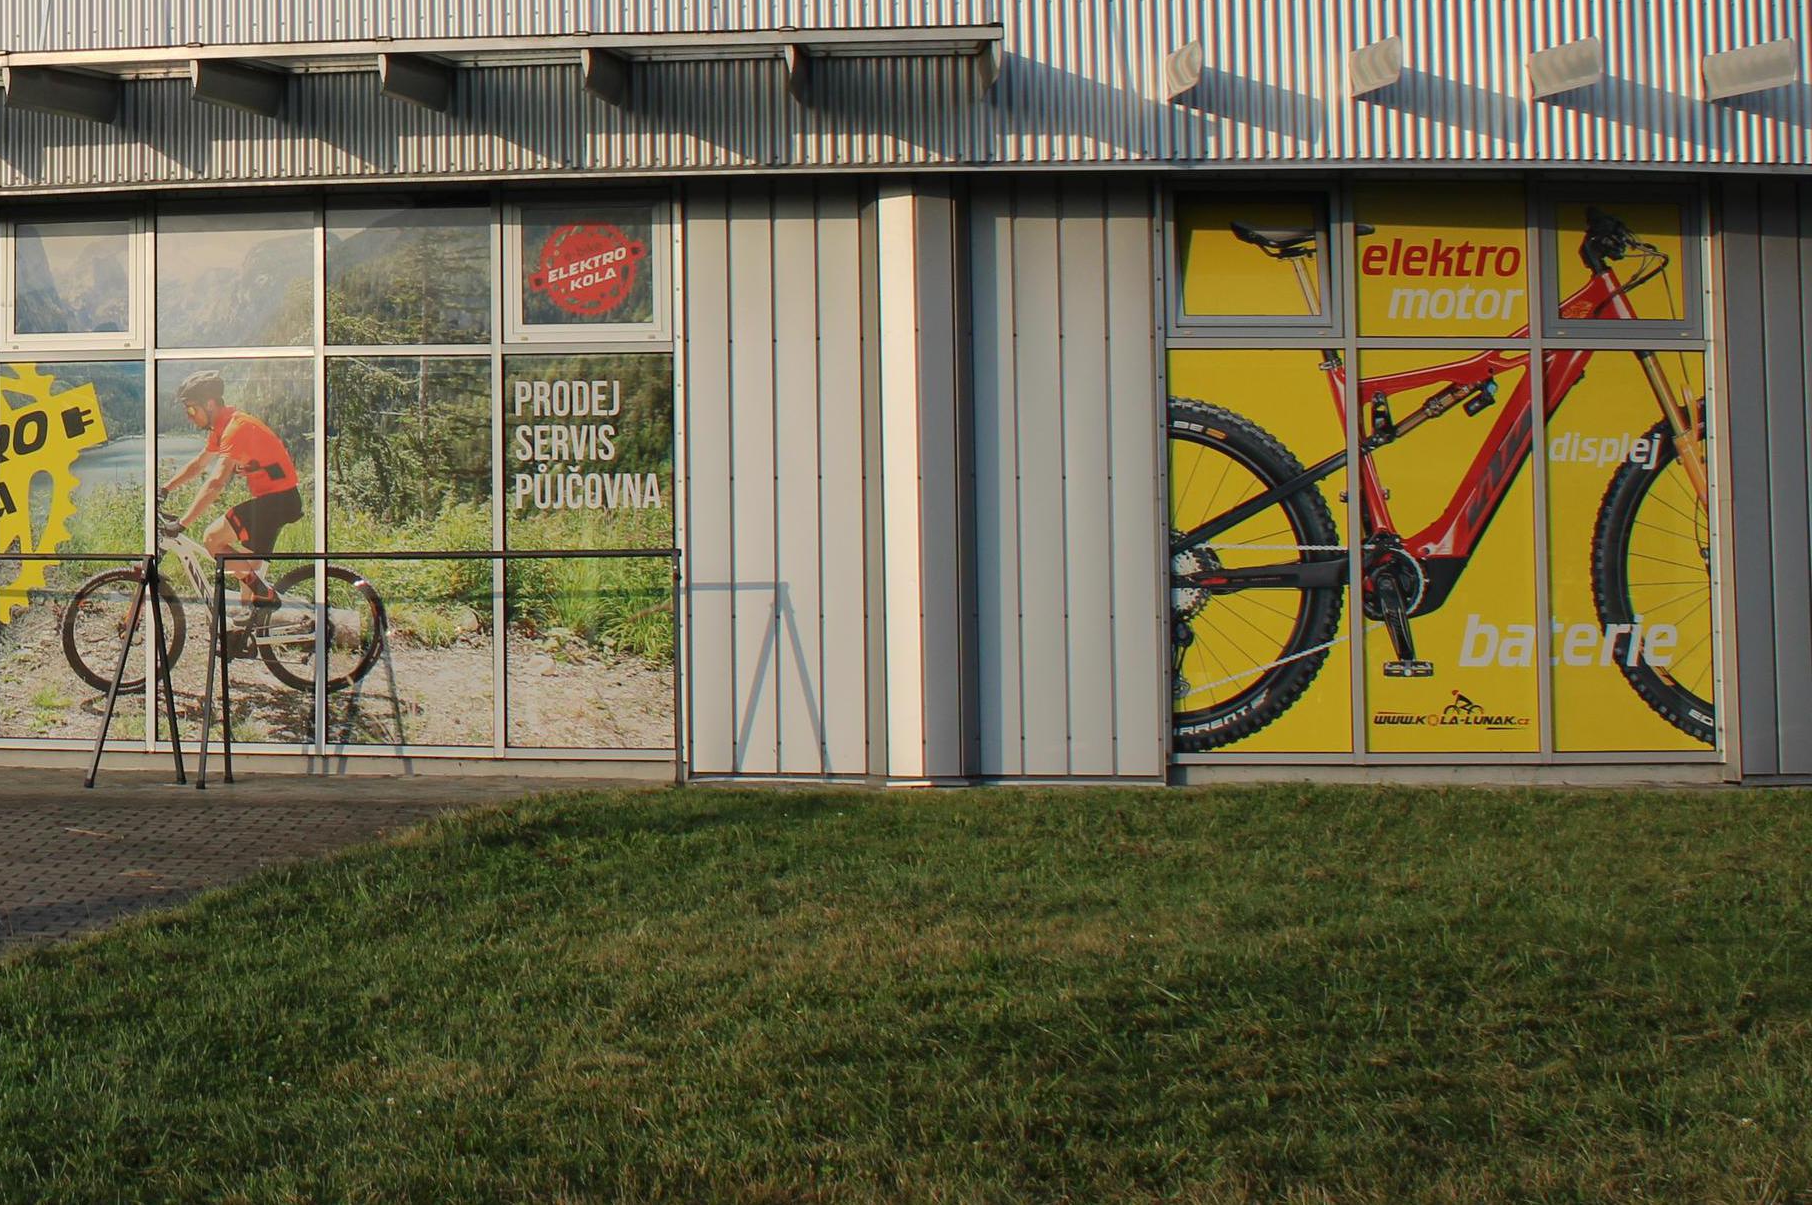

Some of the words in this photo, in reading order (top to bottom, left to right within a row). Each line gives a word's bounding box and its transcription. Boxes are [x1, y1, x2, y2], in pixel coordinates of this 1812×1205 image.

[548, 247, 627, 283] ELEKTRO
[1362, 238, 1521, 277] elektro
[570, 267, 617, 291] KOLA
[1388, 284, 1524, 320] motor
[515, 380, 620, 417] PRODEJ
[515, 424, 616, 461] SERVIS
[1548, 432, 1661, 470] displej
[515, 464, 662, 509] PŮJČOVNA
[1459, 614, 1678, 667] baterie
